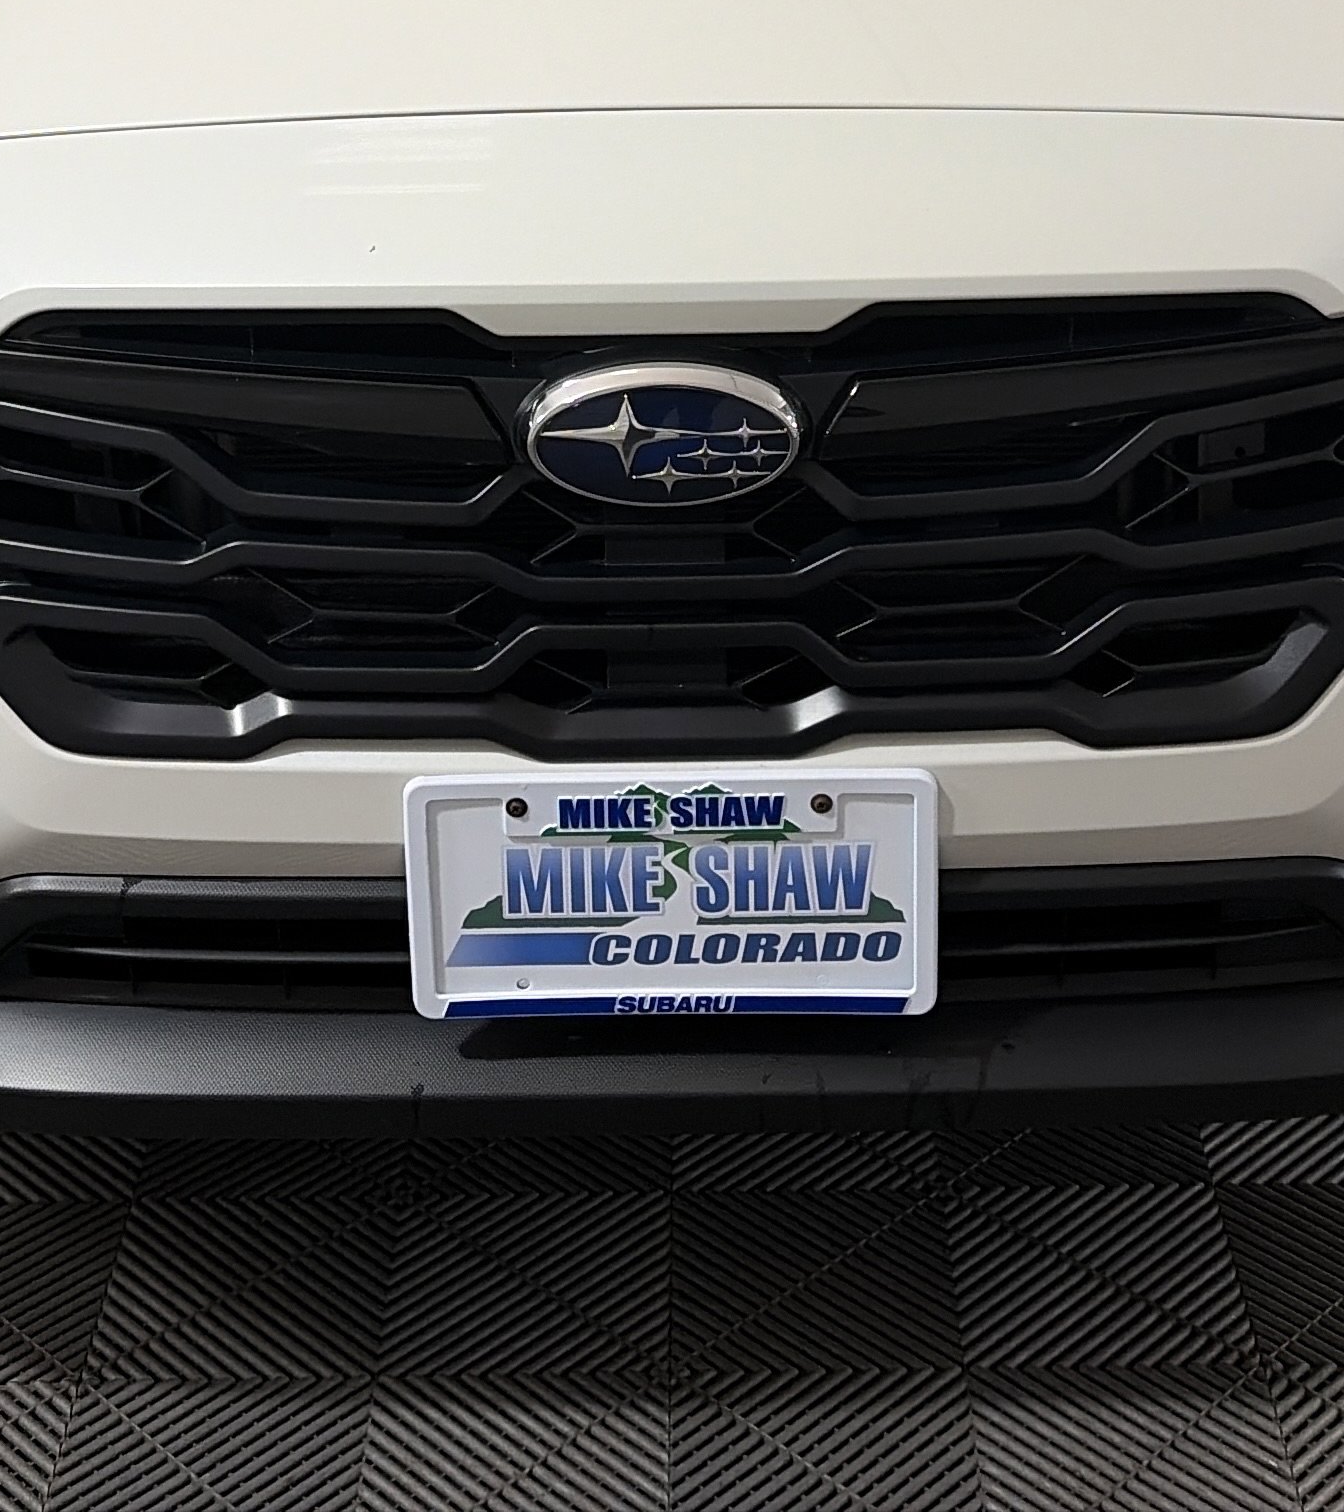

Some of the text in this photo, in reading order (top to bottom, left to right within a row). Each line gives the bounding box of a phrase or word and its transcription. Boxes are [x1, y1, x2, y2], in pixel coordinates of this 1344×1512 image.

[558, 795, 785, 830] MIKE SHAW
[505, 843, 873, 915] MIKE SHAW
[592, 931, 903, 966] COLORADO
[617, 995, 733, 1014] SUBARU
